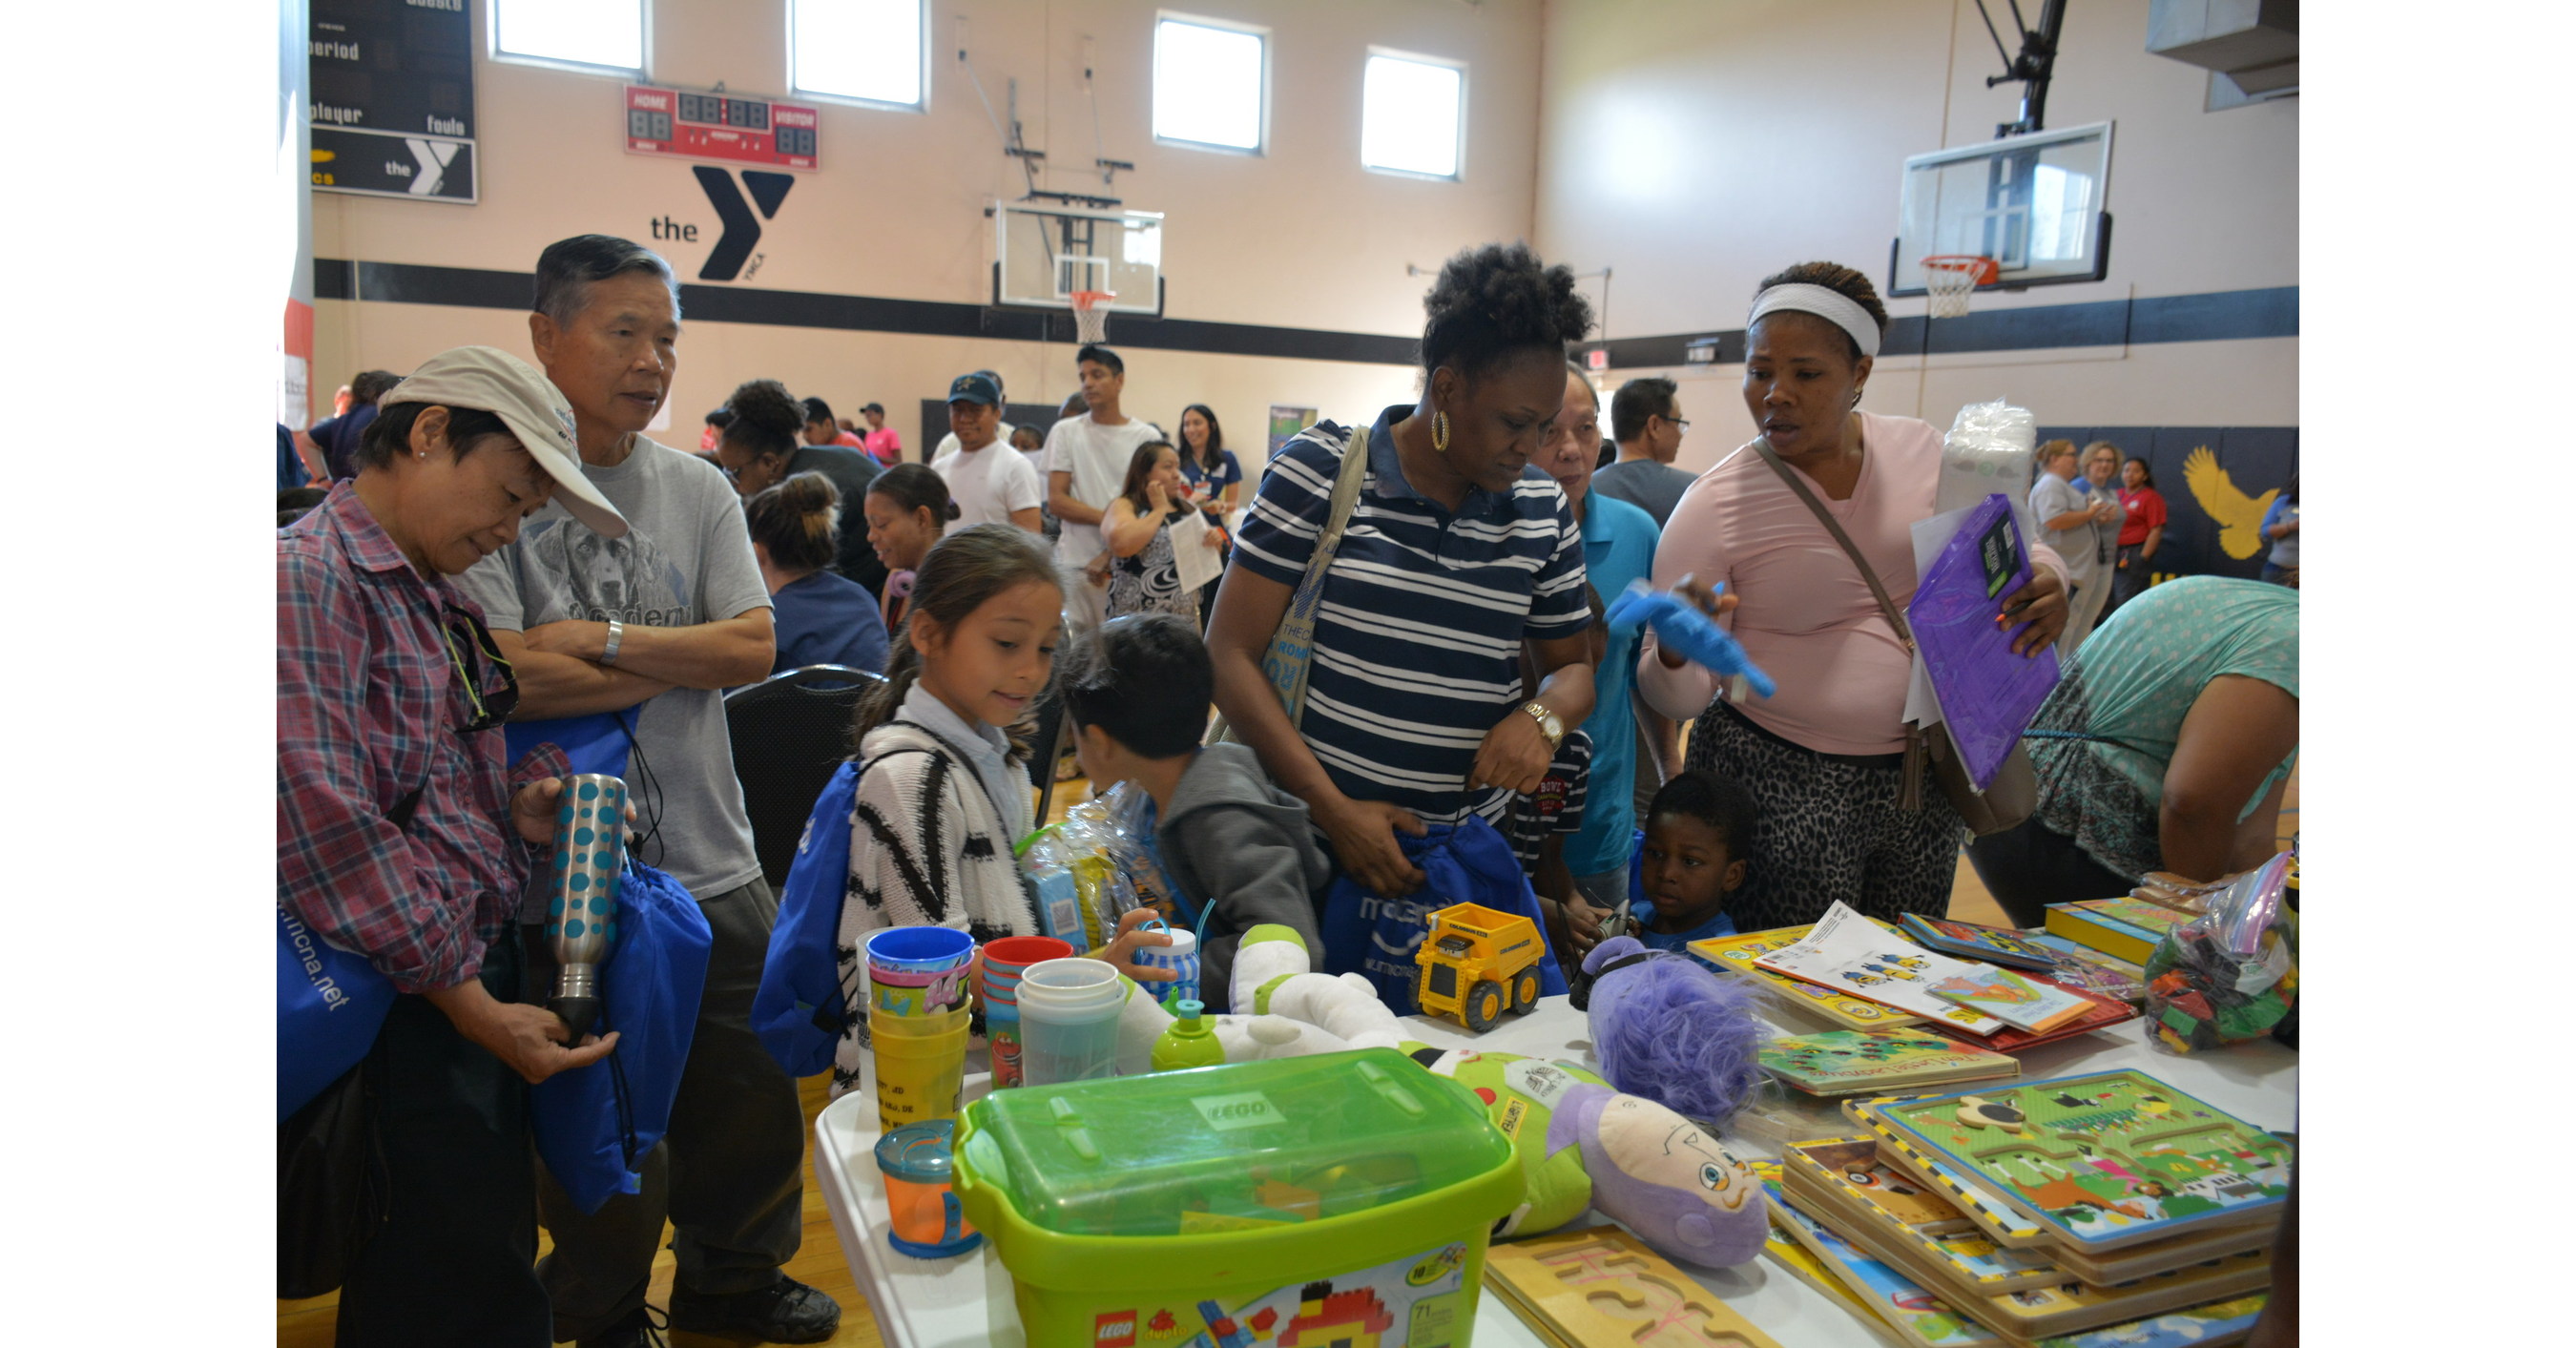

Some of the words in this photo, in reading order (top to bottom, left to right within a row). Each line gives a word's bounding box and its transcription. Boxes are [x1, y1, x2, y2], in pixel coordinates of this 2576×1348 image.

[634, 93, 667, 110] HOME
[427, 114, 465, 135] fouls
[775, 110, 815, 127] VISITOR
[385, 160, 411, 176] the
[651, 215, 698, 242] the
[742, 251, 766, 281] YMCA
[1207, 1100, 1271, 1122] LEGO
[1413, 1265, 1426, 1278] 10
[1416, 1303, 1430, 1320] 71
[1098, 1320, 1133, 1338] LEGO
